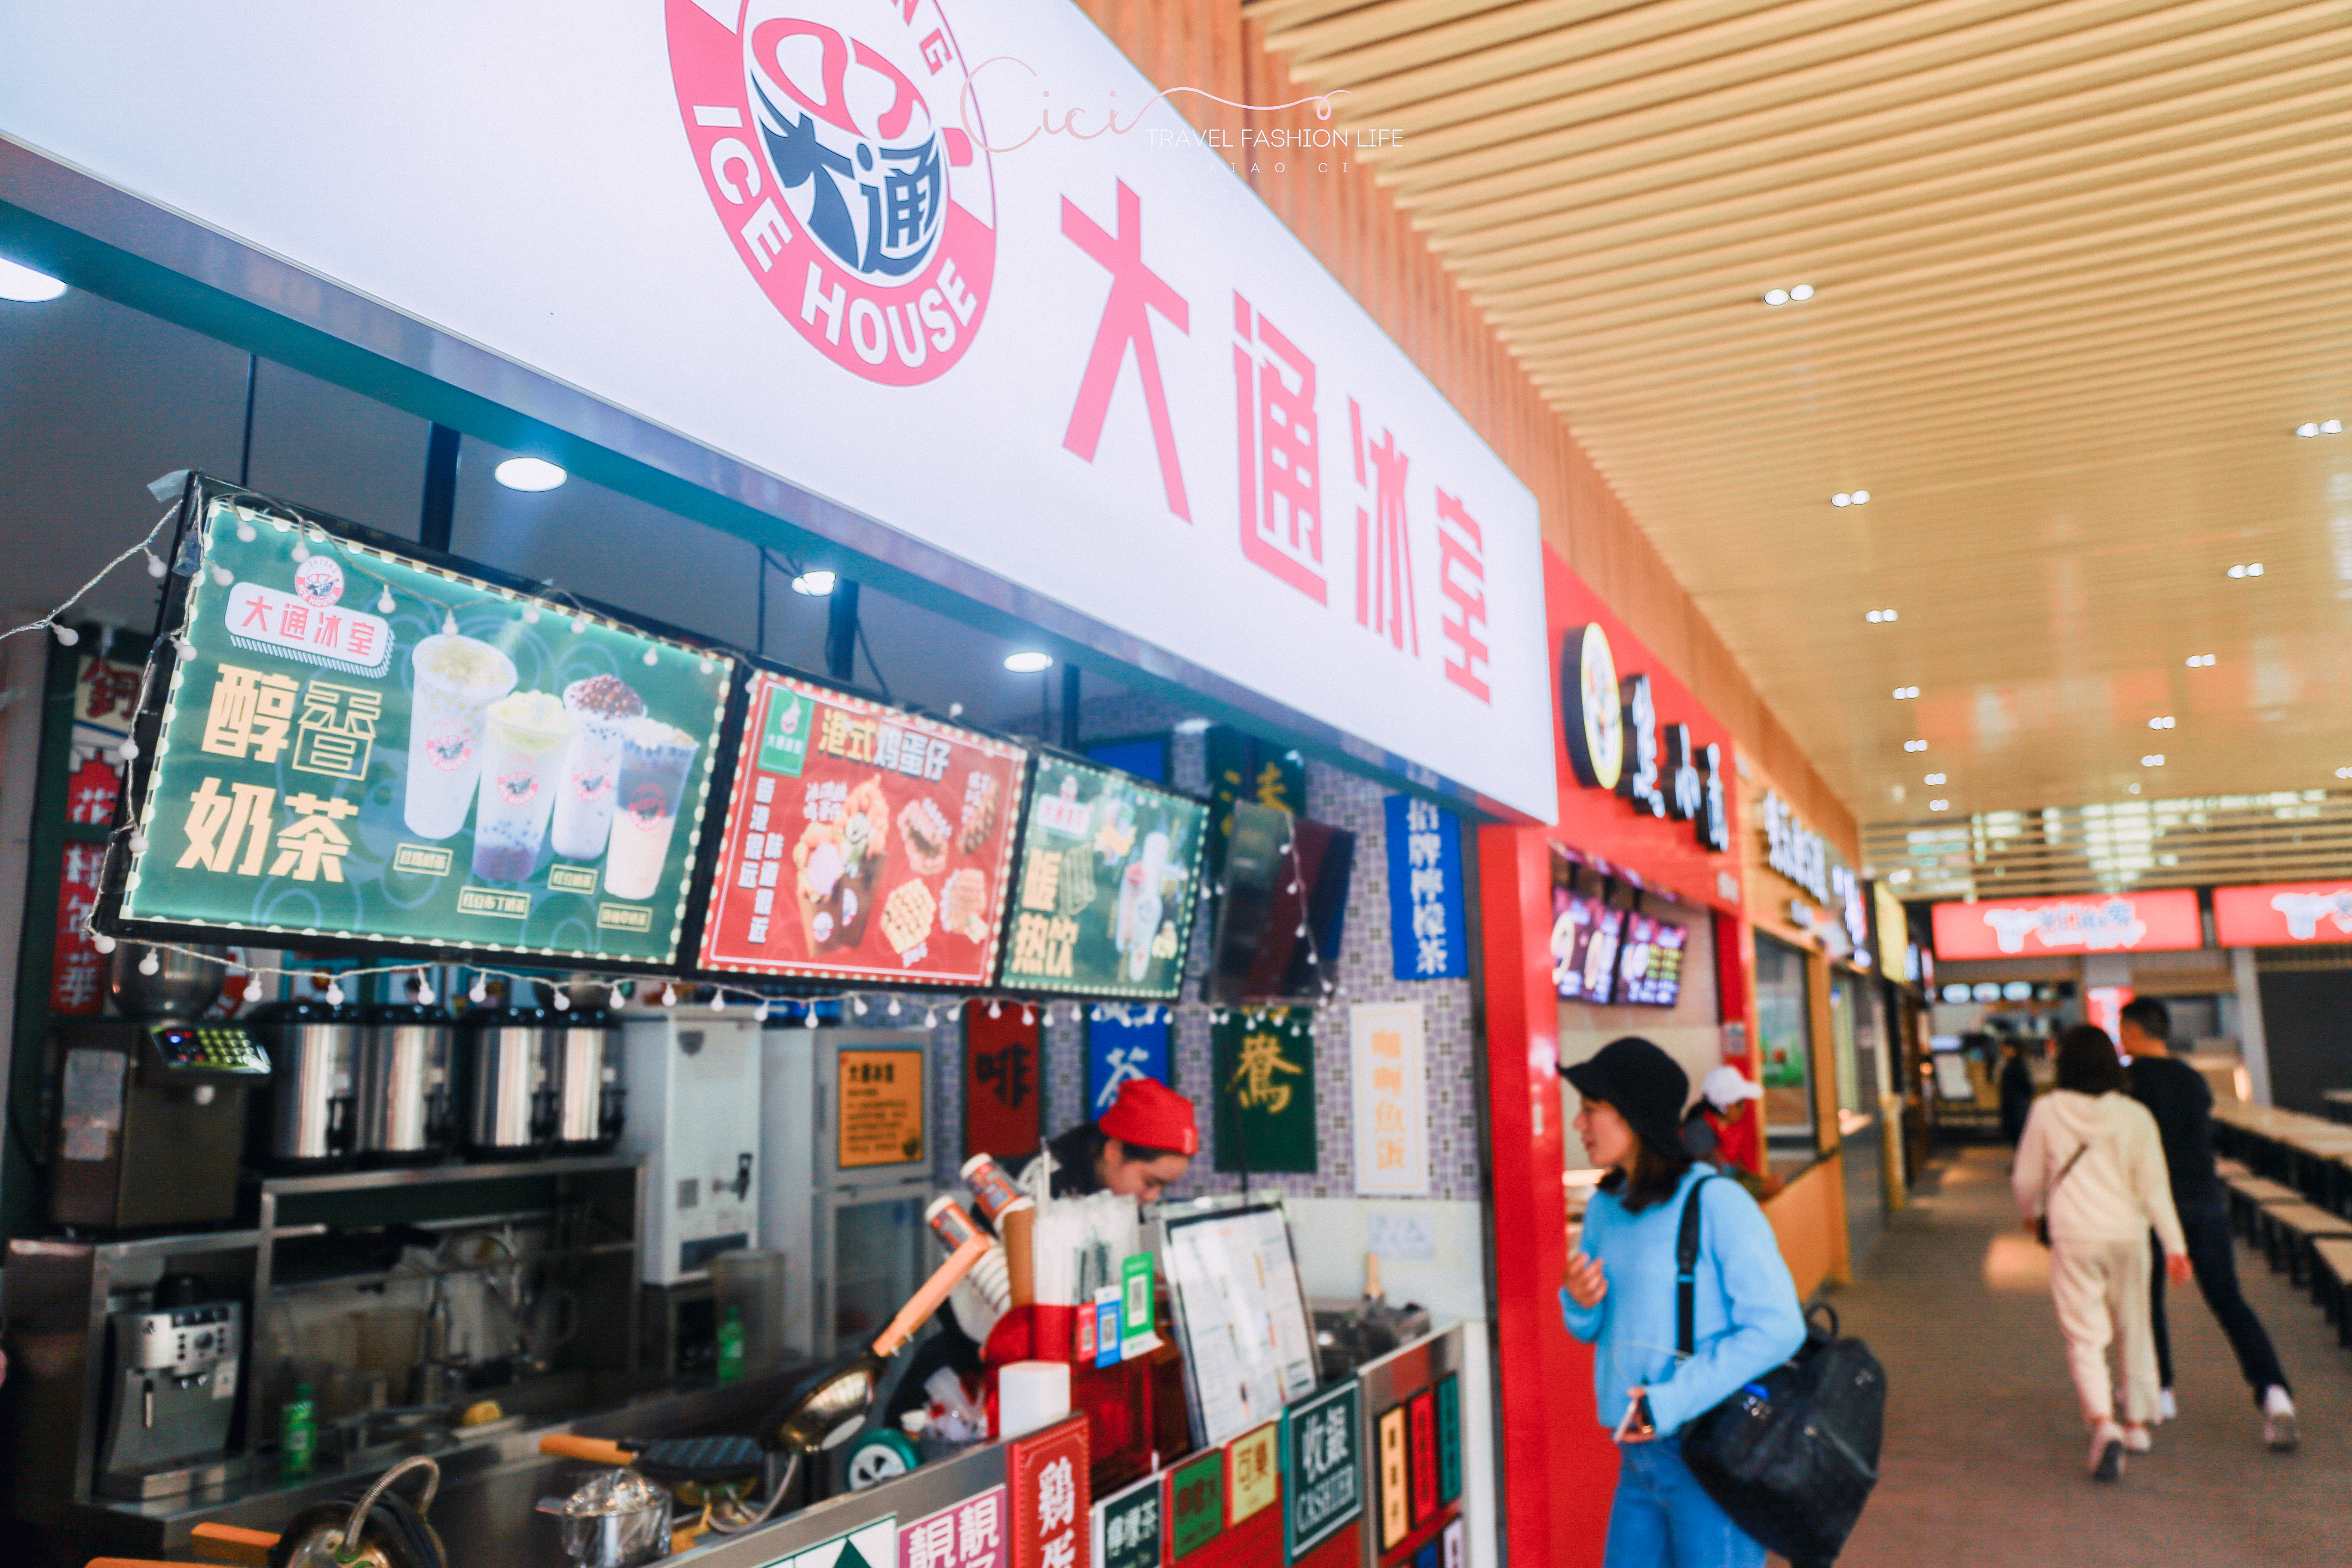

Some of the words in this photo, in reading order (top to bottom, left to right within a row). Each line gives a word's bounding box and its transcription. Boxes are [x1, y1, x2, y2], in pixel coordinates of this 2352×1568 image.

[692, 105, 793, 273] ICE
[800, 258, 978, 368] HOUSE
[1061, 177, 1491, 706] 大通冰室
[242, 596, 375, 656] 大通冰室
[201, 664, 382, 781] 醇香
[818, 708, 951, 781] 港式鸡蛋仔
[175, 777, 359, 882] 奶茶
